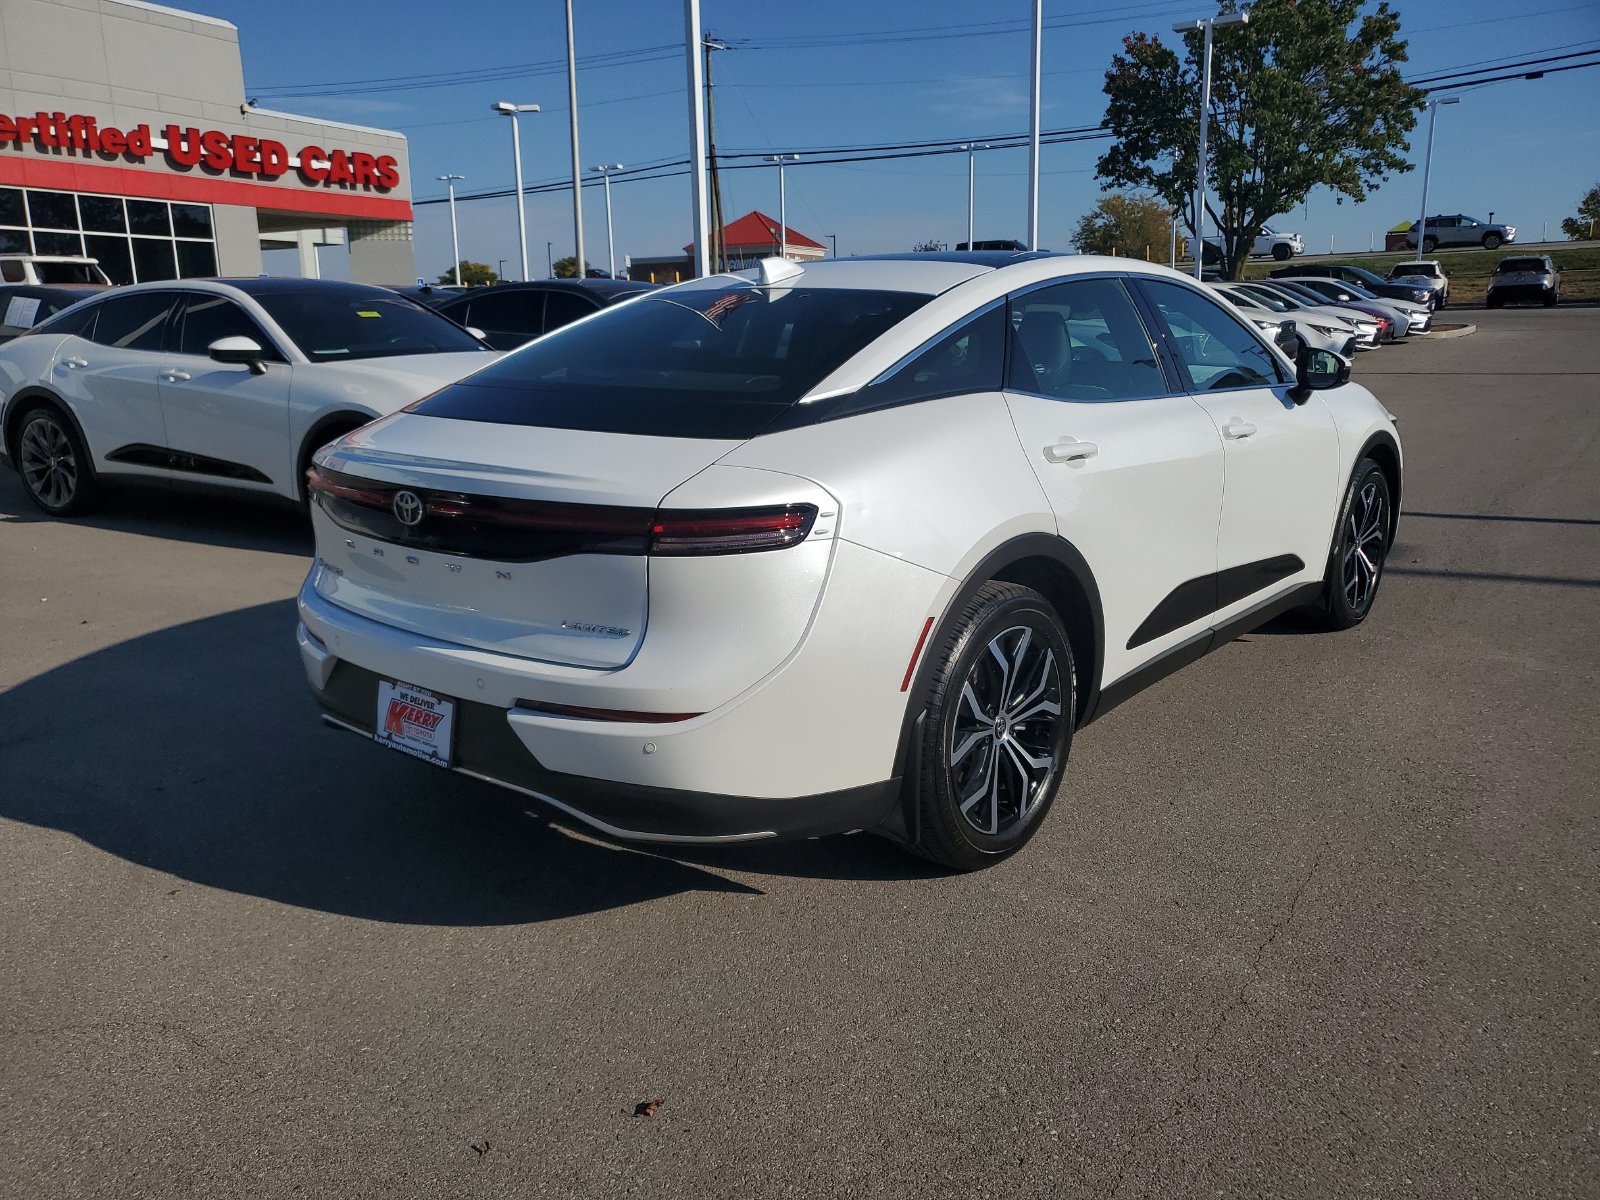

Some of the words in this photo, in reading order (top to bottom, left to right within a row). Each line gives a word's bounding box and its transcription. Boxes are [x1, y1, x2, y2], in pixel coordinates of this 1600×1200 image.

[163, 124, 290, 175] USED
[299, 145, 400, 189] CARS
[399, 691, 408, 702] WE
[409, 695, 435, 709] DELIVER
[386, 700, 441, 735] KERRY
[374, 734, 448, 768] kerryautomotive.com
